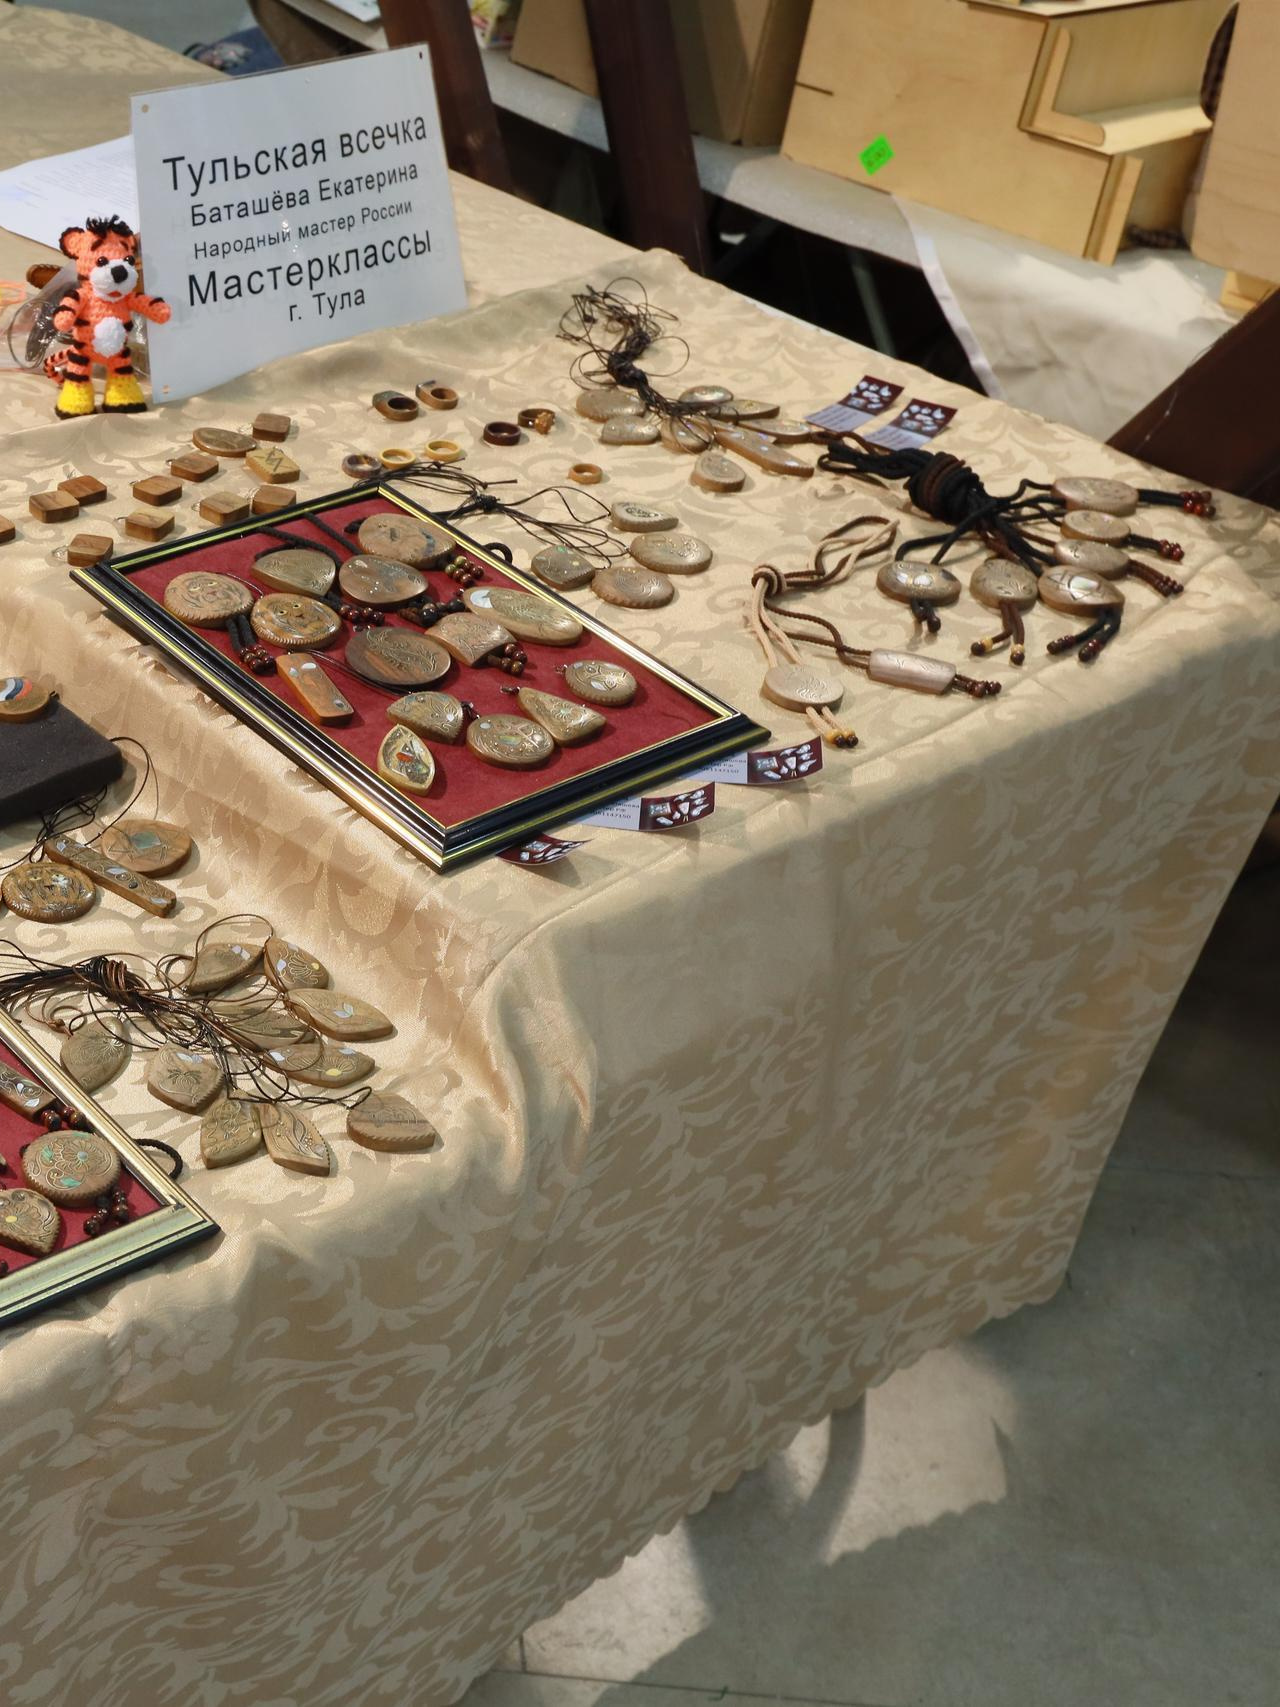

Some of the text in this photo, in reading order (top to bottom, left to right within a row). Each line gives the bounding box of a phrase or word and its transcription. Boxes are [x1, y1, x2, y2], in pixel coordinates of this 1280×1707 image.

[162, 138, 327, 197] Тульская
[340, 117, 427, 158] всечка
[191, 164, 419, 227] Баташёва Екатерина
[194, 202, 413, 260] Народный мастер России
[188, 230, 432, 307] Мастерклассы
[289, 289, 366, 323] г. Тула
